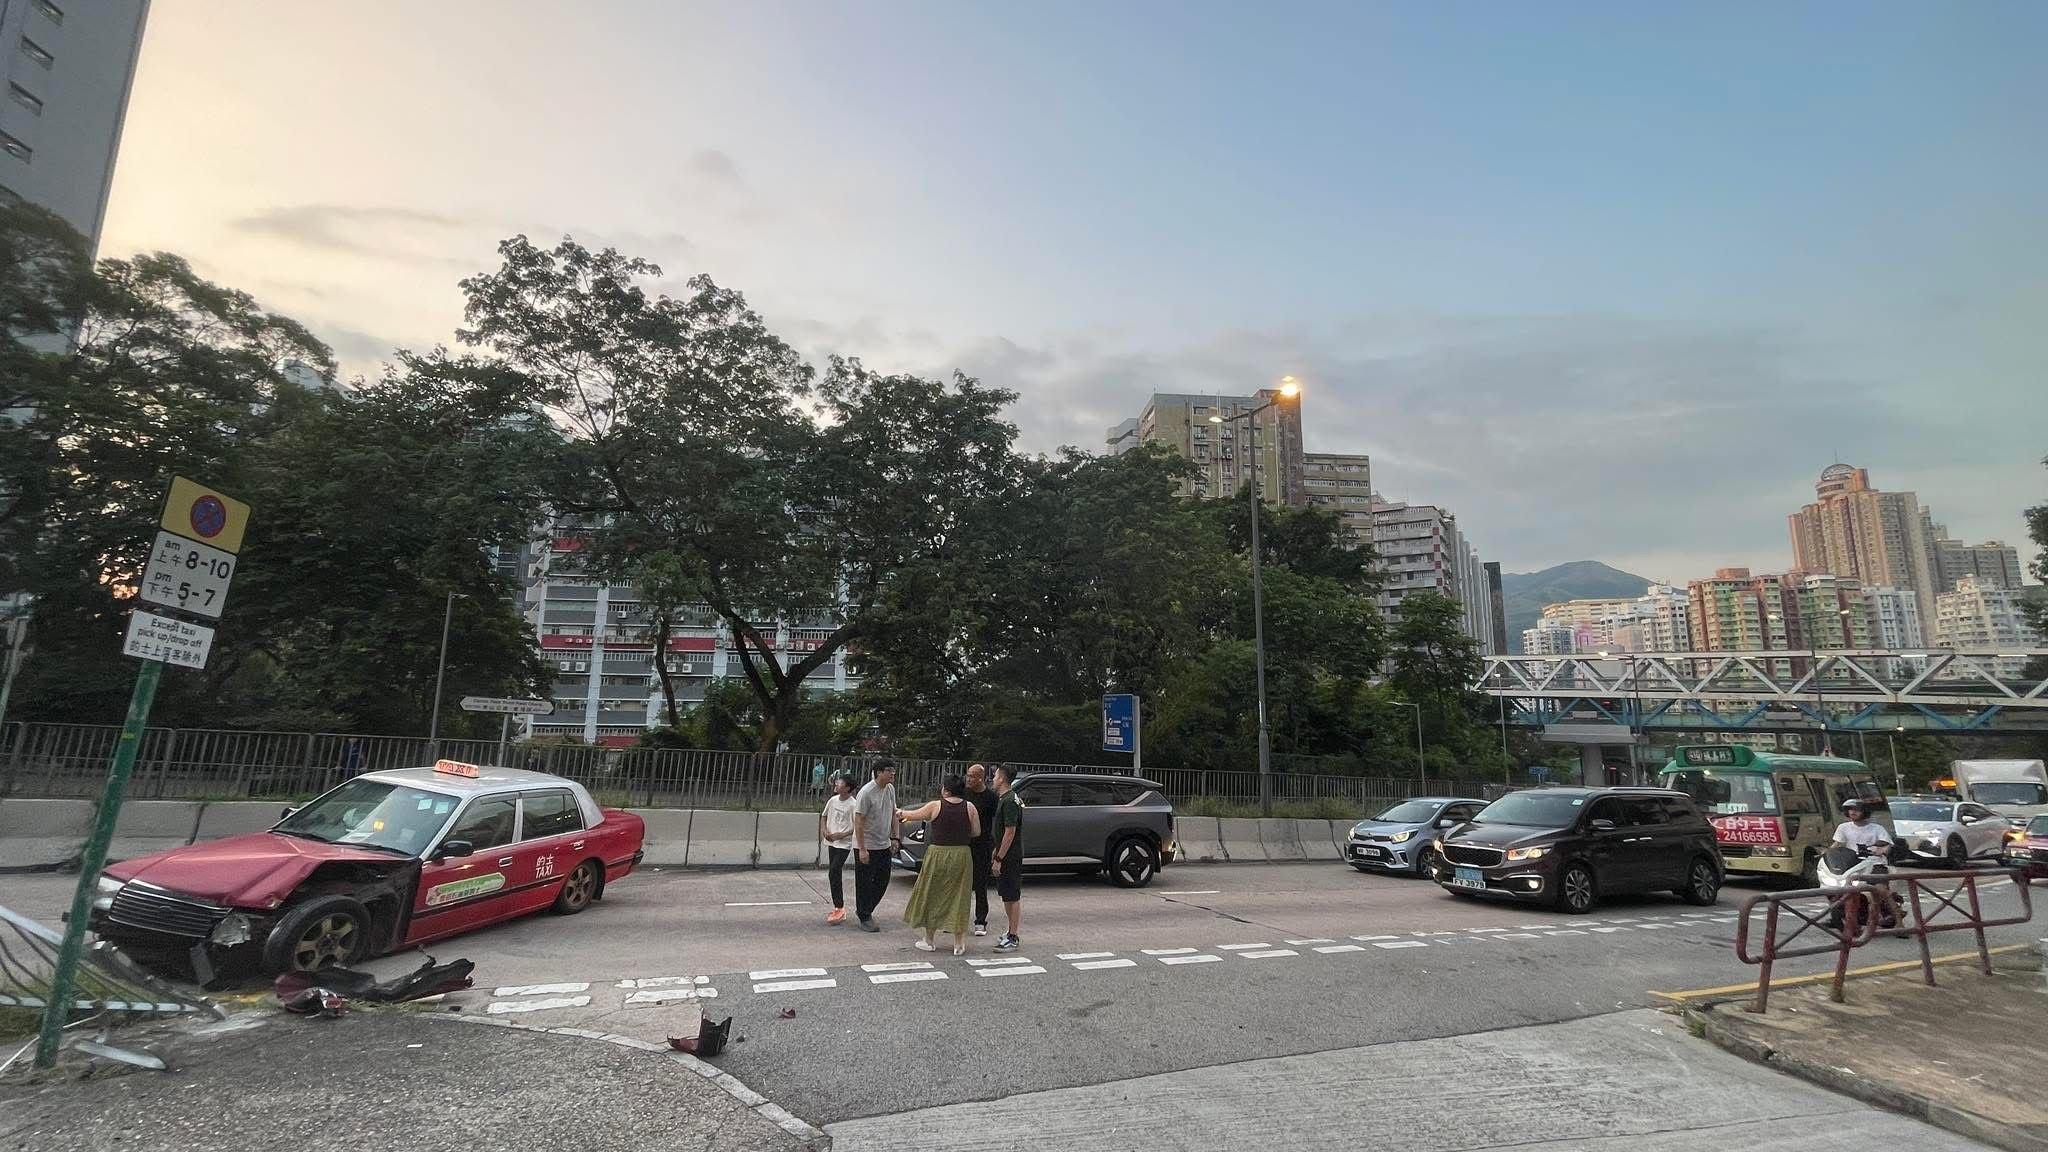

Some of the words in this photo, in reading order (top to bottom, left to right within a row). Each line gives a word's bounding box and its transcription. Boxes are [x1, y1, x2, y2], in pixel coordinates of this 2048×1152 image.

[165, 540, 181, 552] am
[154, 550, 183, 567] 上午
[185, 550, 230, 580] 8-10
[153, 570, 172, 584] pm
[147, 581, 174, 599] 下午
[151, 618, 180, 633] Except
[181, 625, 197, 637] taxi
[137, 628, 157, 639] pick
[157, 632, 189, 646] up/drop
[189, 639, 203, 648] off
[438, 760, 472, 775] TAXI
[535, 854, 554, 867] 的士
[535, 864, 553, 879] TAXI
